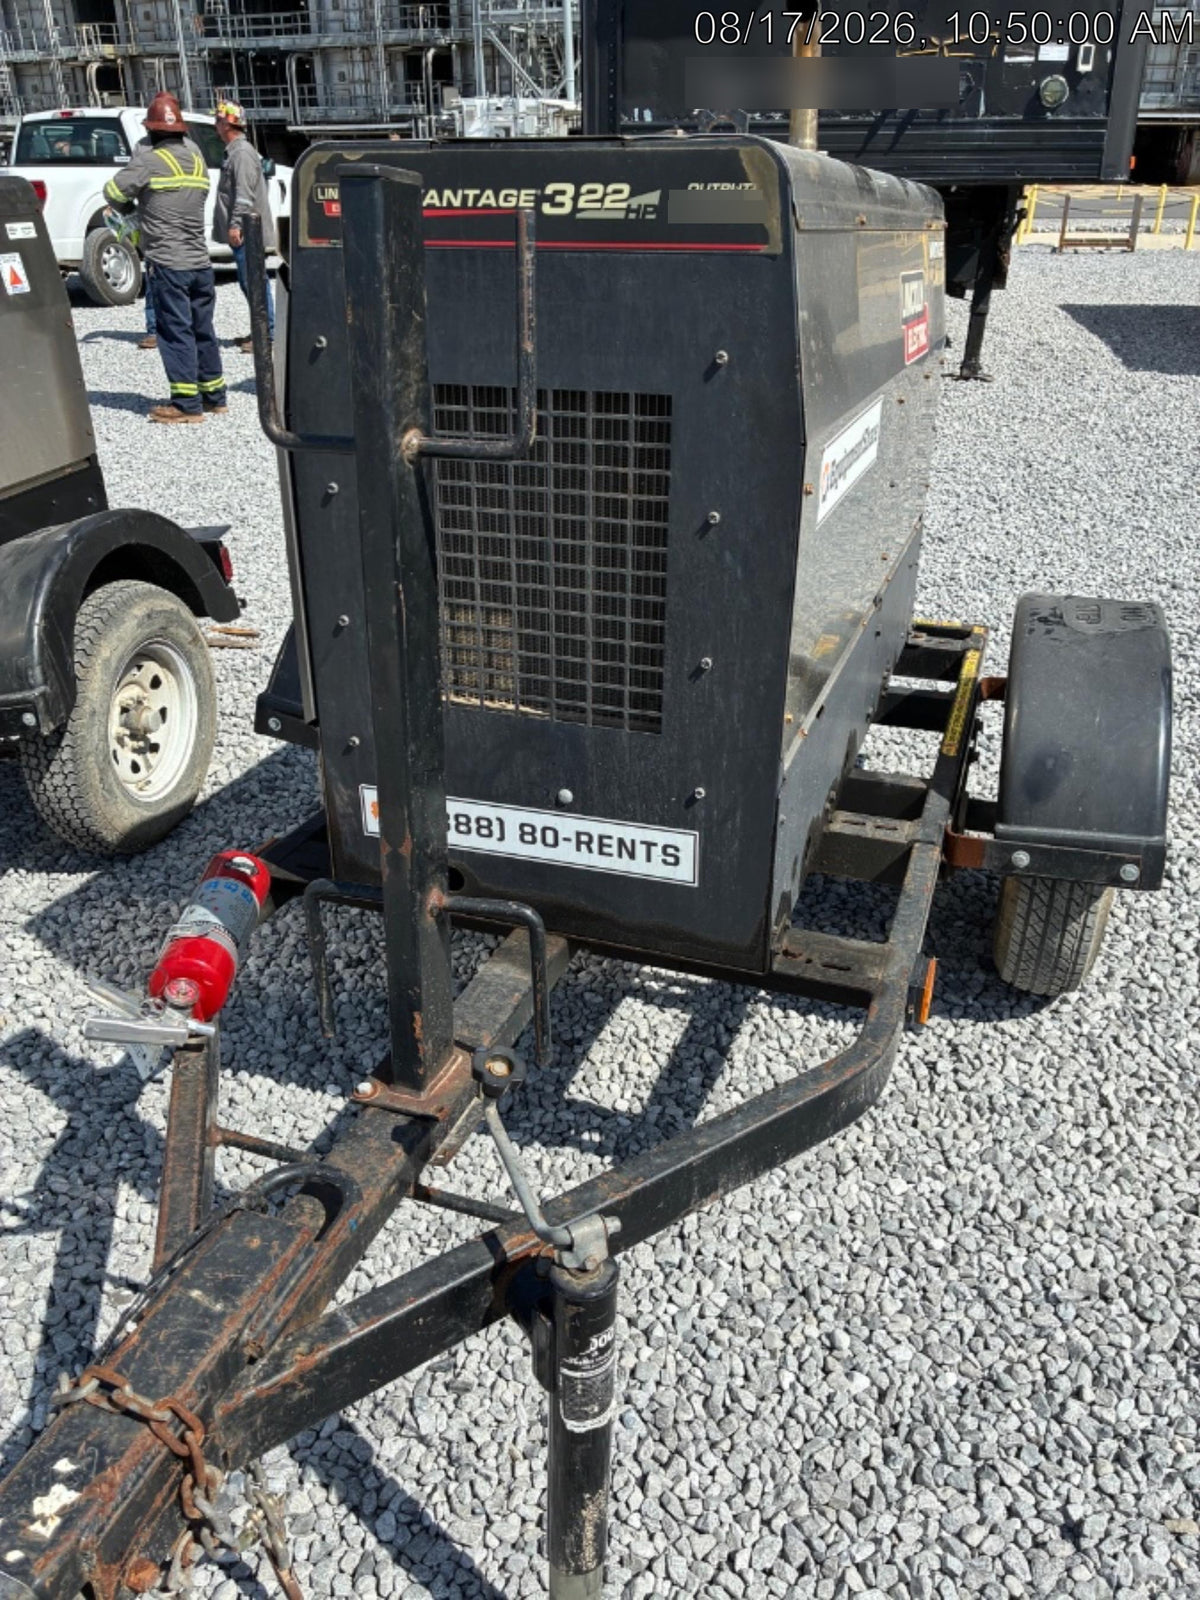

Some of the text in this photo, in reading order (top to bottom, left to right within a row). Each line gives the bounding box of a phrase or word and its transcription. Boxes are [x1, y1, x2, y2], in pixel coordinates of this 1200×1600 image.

[421, 188, 536, 207] ANTAGE
[541, 182, 631, 216] 322
[446, 812, 681, 867] 88) 80-RENTS
